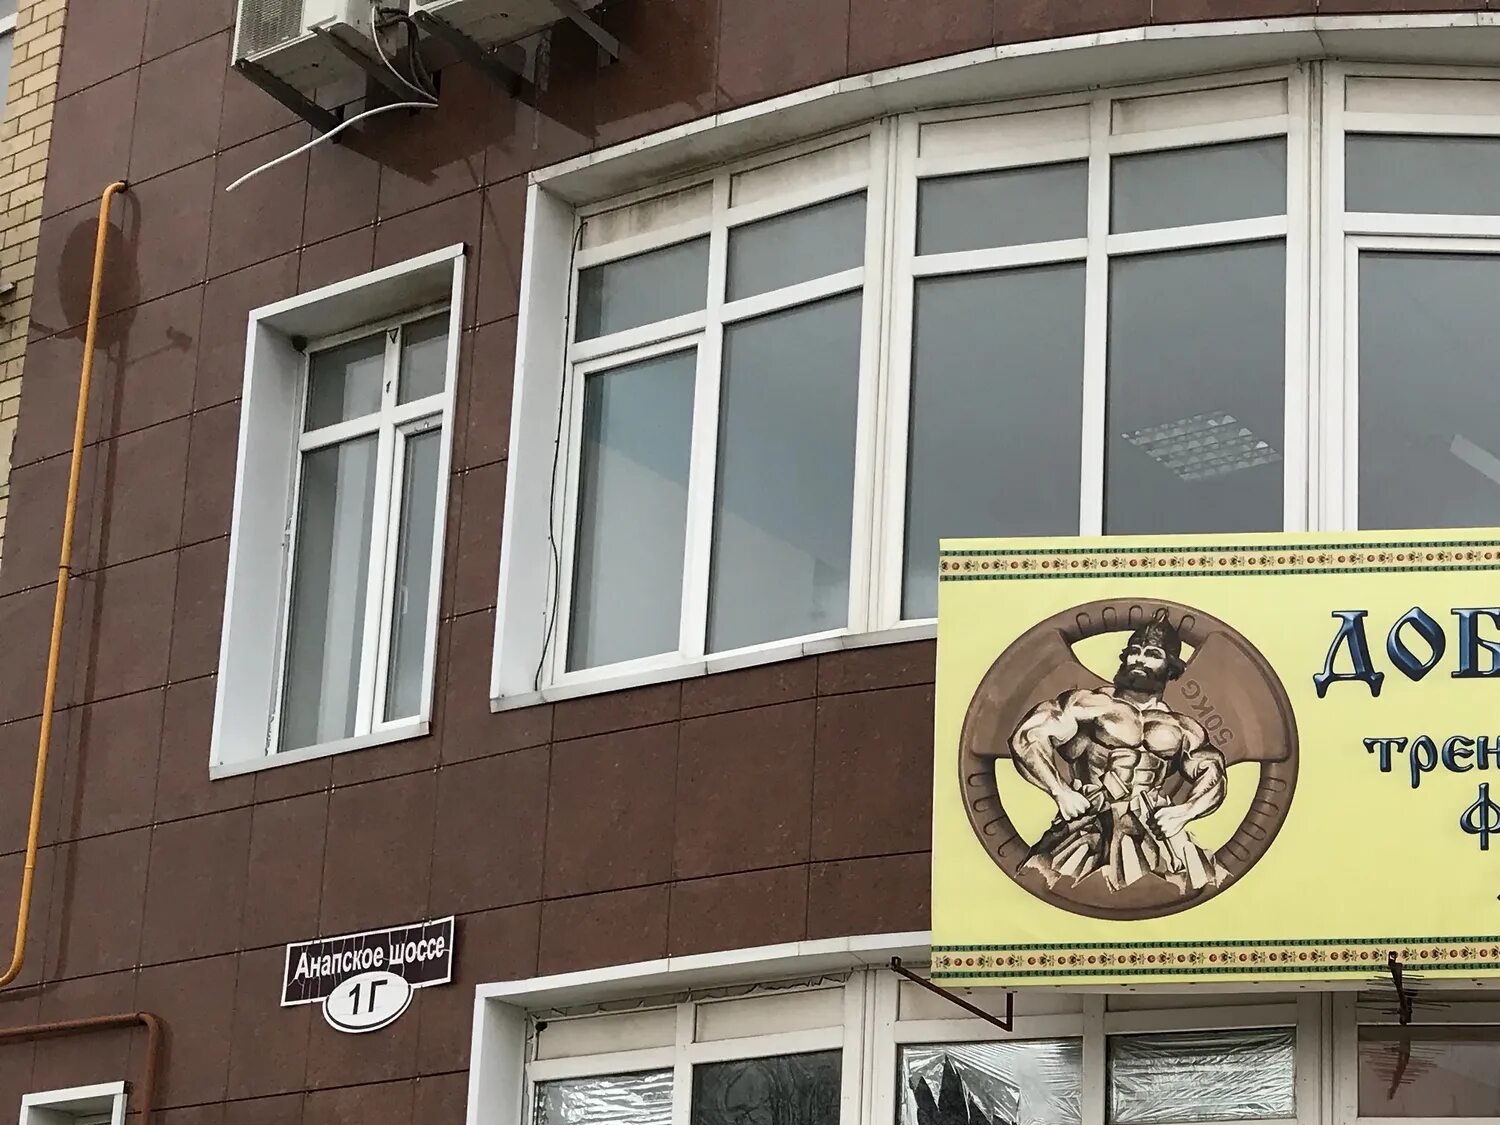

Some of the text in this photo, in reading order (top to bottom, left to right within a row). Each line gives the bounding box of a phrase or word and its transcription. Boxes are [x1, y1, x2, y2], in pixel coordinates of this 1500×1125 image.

[1181, 679, 1235, 745] 50KG
[294, 935, 446, 980] Анапское шоссе
[348, 979, 389, 1015] 1Г
